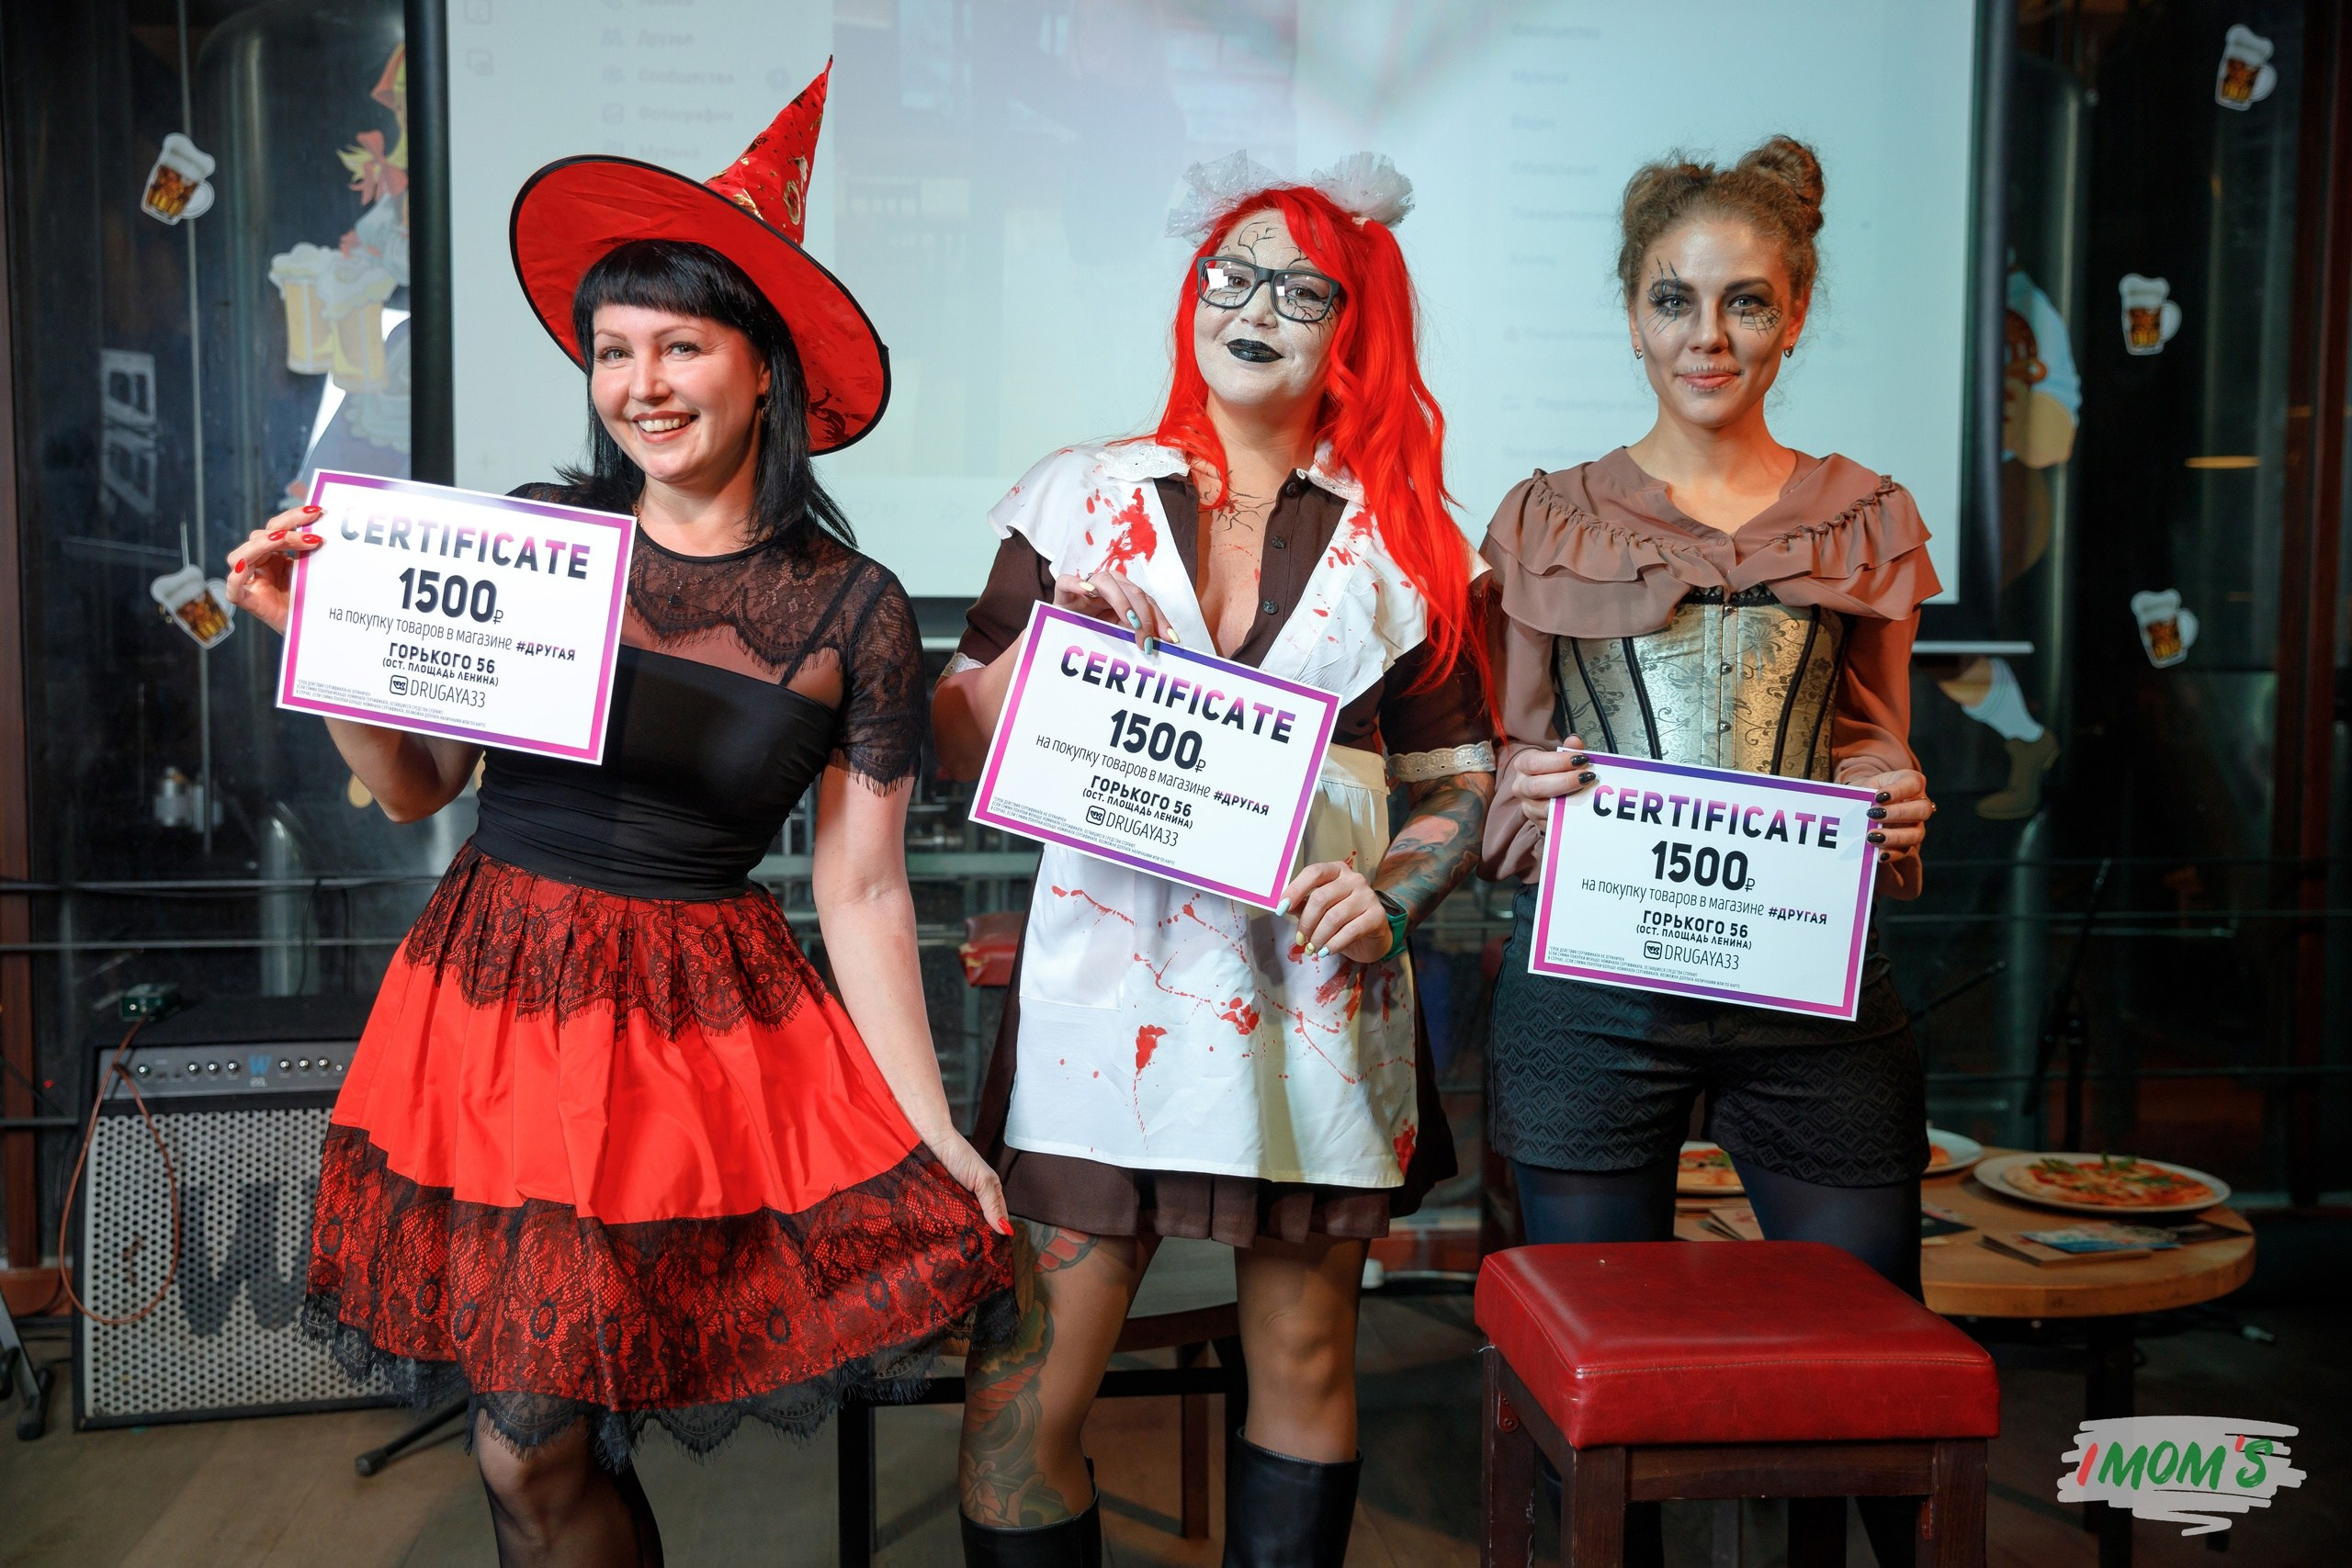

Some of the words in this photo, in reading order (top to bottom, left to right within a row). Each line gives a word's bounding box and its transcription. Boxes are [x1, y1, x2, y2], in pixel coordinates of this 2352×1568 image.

[340, 512, 591, 580] CERTIFICATE
[329, 607, 343, 621] на
[345, 610, 394, 635] покупку
[396, 618, 445, 641] товаров
[447, 627, 454, 640] в
[456, 629, 513, 650] магазине
[515, 640, 575, 661] #ДРУГАЯ
[382, 657, 405, 670] (ОСТ.
[408, 662, 456, 679] ПЛОЩАДЬ
[457, 671, 499, 687] ЛЕНИНА)
[389, 642, 472, 670] ГОРЬКОГО
[476, 657, 495, 674] 56
[410, 679, 486, 708] DRUGAYA33
[1061, 647, 1296, 744] CERTIFICATE
[1035, 734, 1051, 749] на
[1051, 739, 1101, 768] покупку
[1102, 754, 1148, 779] товаров
[1148, 769, 1157, 782] в
[1157, 772, 1211, 798] магазине
[1213, 790, 1270, 816] #ДРУГАЯ
[1091, 774, 1170, 810] ГОРЬКОГО
[1172, 800, 1193, 818] 56
[1082, 787, 1104, 802] (ОСТ.
[1106, 795, 1152, 817] ПЛОЩАДЬ
[1153, 810, 1193, 829] ЛЕНИНА)
[1593, 784, 1840, 849] CERTIFICATE
[1105, 812, 1179, 847] DRUGAYA33
[1581, 878, 1596, 891] на
[1598, 881, 1647, 904] покупку
[1649, 888, 1698, 908] товаров
[1699, 896, 1707, 908] в
[1709, 897, 1765, 916] магазине
[1768, 907, 1827, 925] #ДРУГАЯ
[1636, 924, 1659, 936] (ОСТ.
[1661, 928, 1709, 943] ПЛОЩАДЬ
[1711, 936, 1752, 951] ЛЕНИНА)
[1643, 909, 1725, 935] ГОРЬКОГО
[1729, 922, 1748, 939] 56
[1664, 944, 1739, 970] DRUGAYA33
